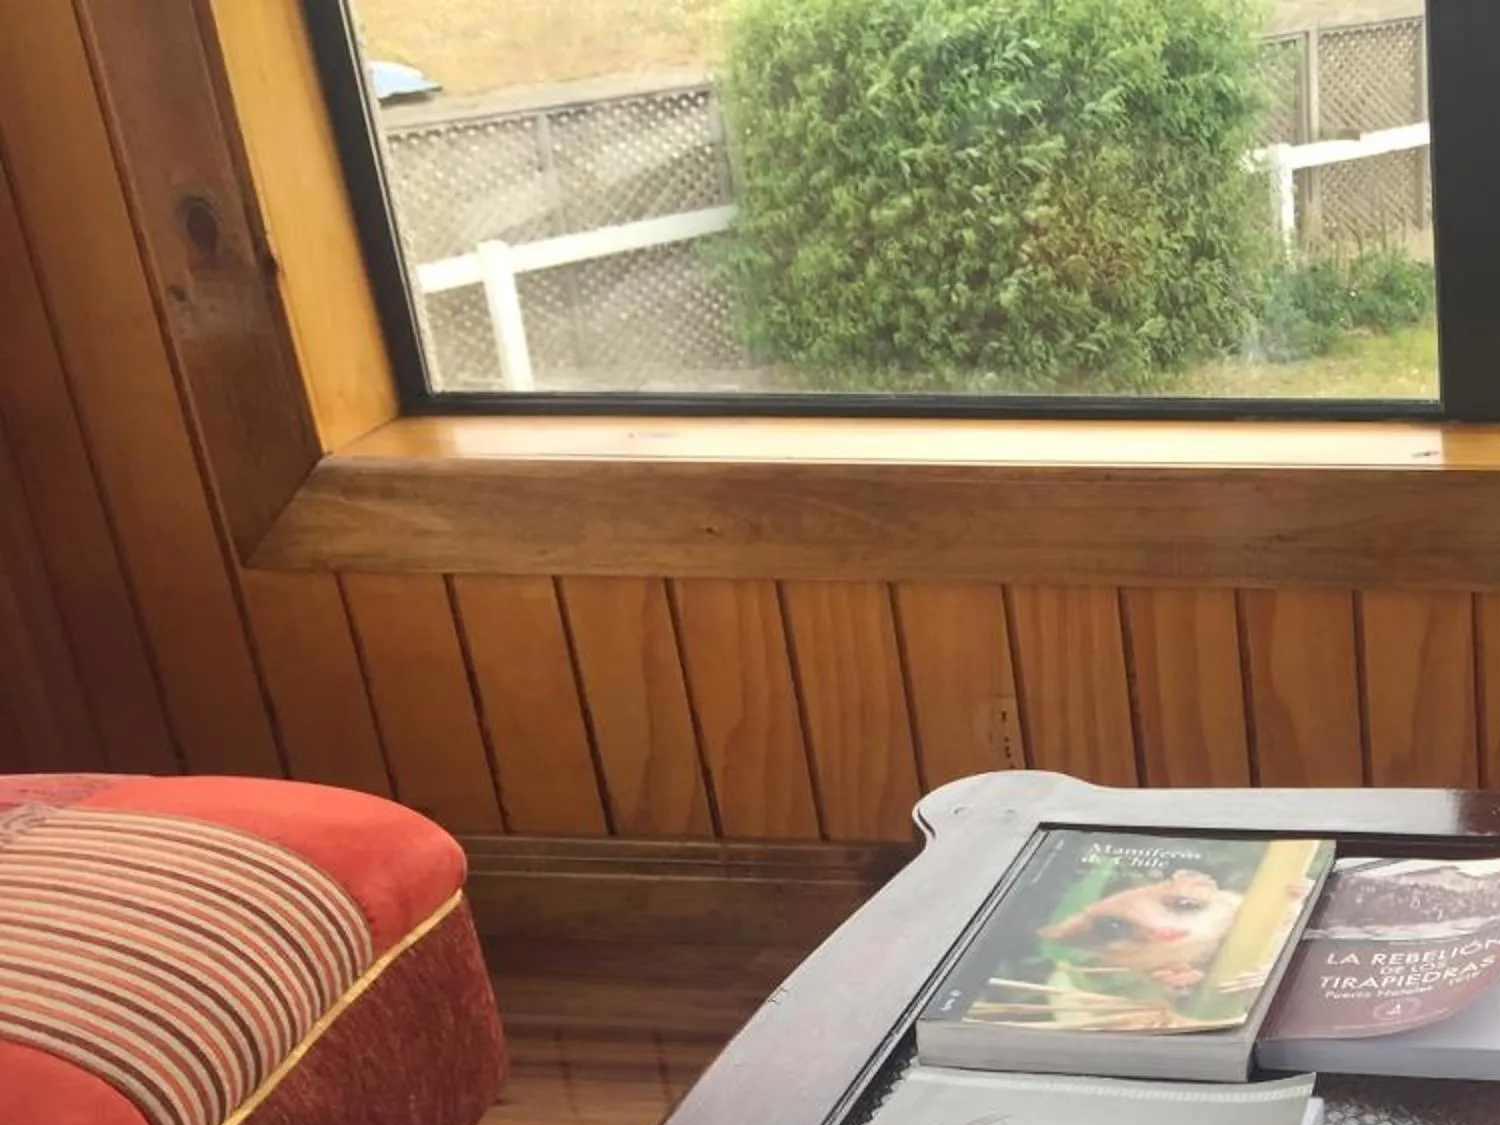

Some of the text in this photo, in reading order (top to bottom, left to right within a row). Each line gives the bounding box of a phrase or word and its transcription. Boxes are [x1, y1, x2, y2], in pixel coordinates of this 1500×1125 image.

[1112, 855, 1170, 869] Chile
[1326, 952, 1361, 966] LA
[1319, 953, 1497, 989] TIRAPIEDRAS
